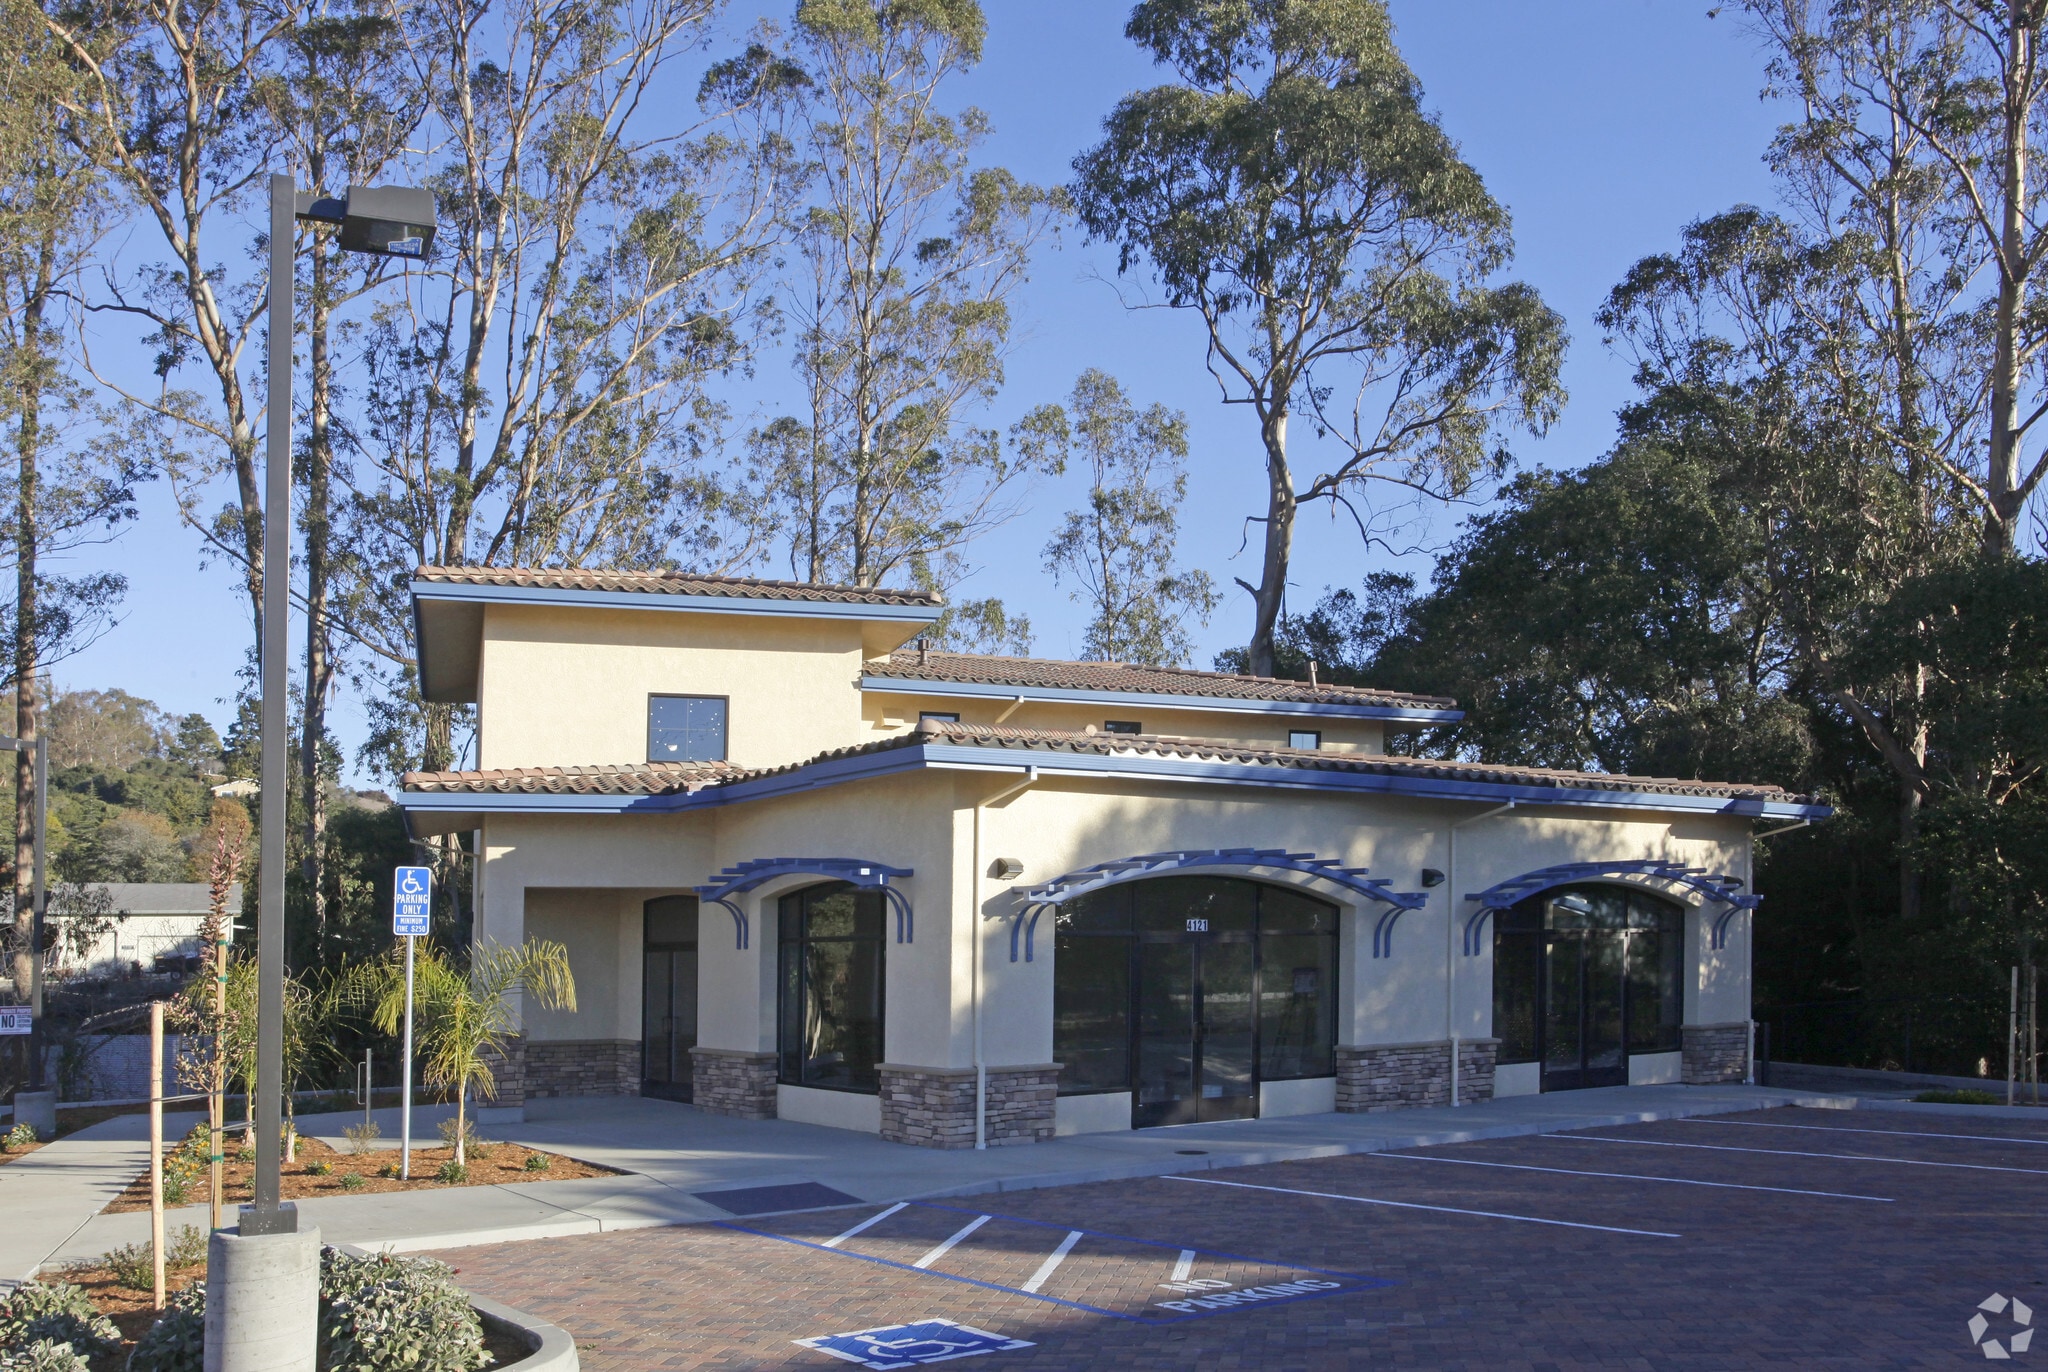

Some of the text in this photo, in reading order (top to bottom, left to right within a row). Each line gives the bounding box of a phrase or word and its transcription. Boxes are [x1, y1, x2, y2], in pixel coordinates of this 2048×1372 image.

[396, 894, 428, 904] PARKING
[402, 904, 422, 915] ONLY
[400, 917, 423, 925] MINIMUM
[1187, 919, 1207, 931] 4121
[410, 925, 426, 933] $250
[1, 1014, 15, 1028] NO
[1157, 1278, 1232, 1293] NO
[1154, 1279, 1341, 1313] PARKING
